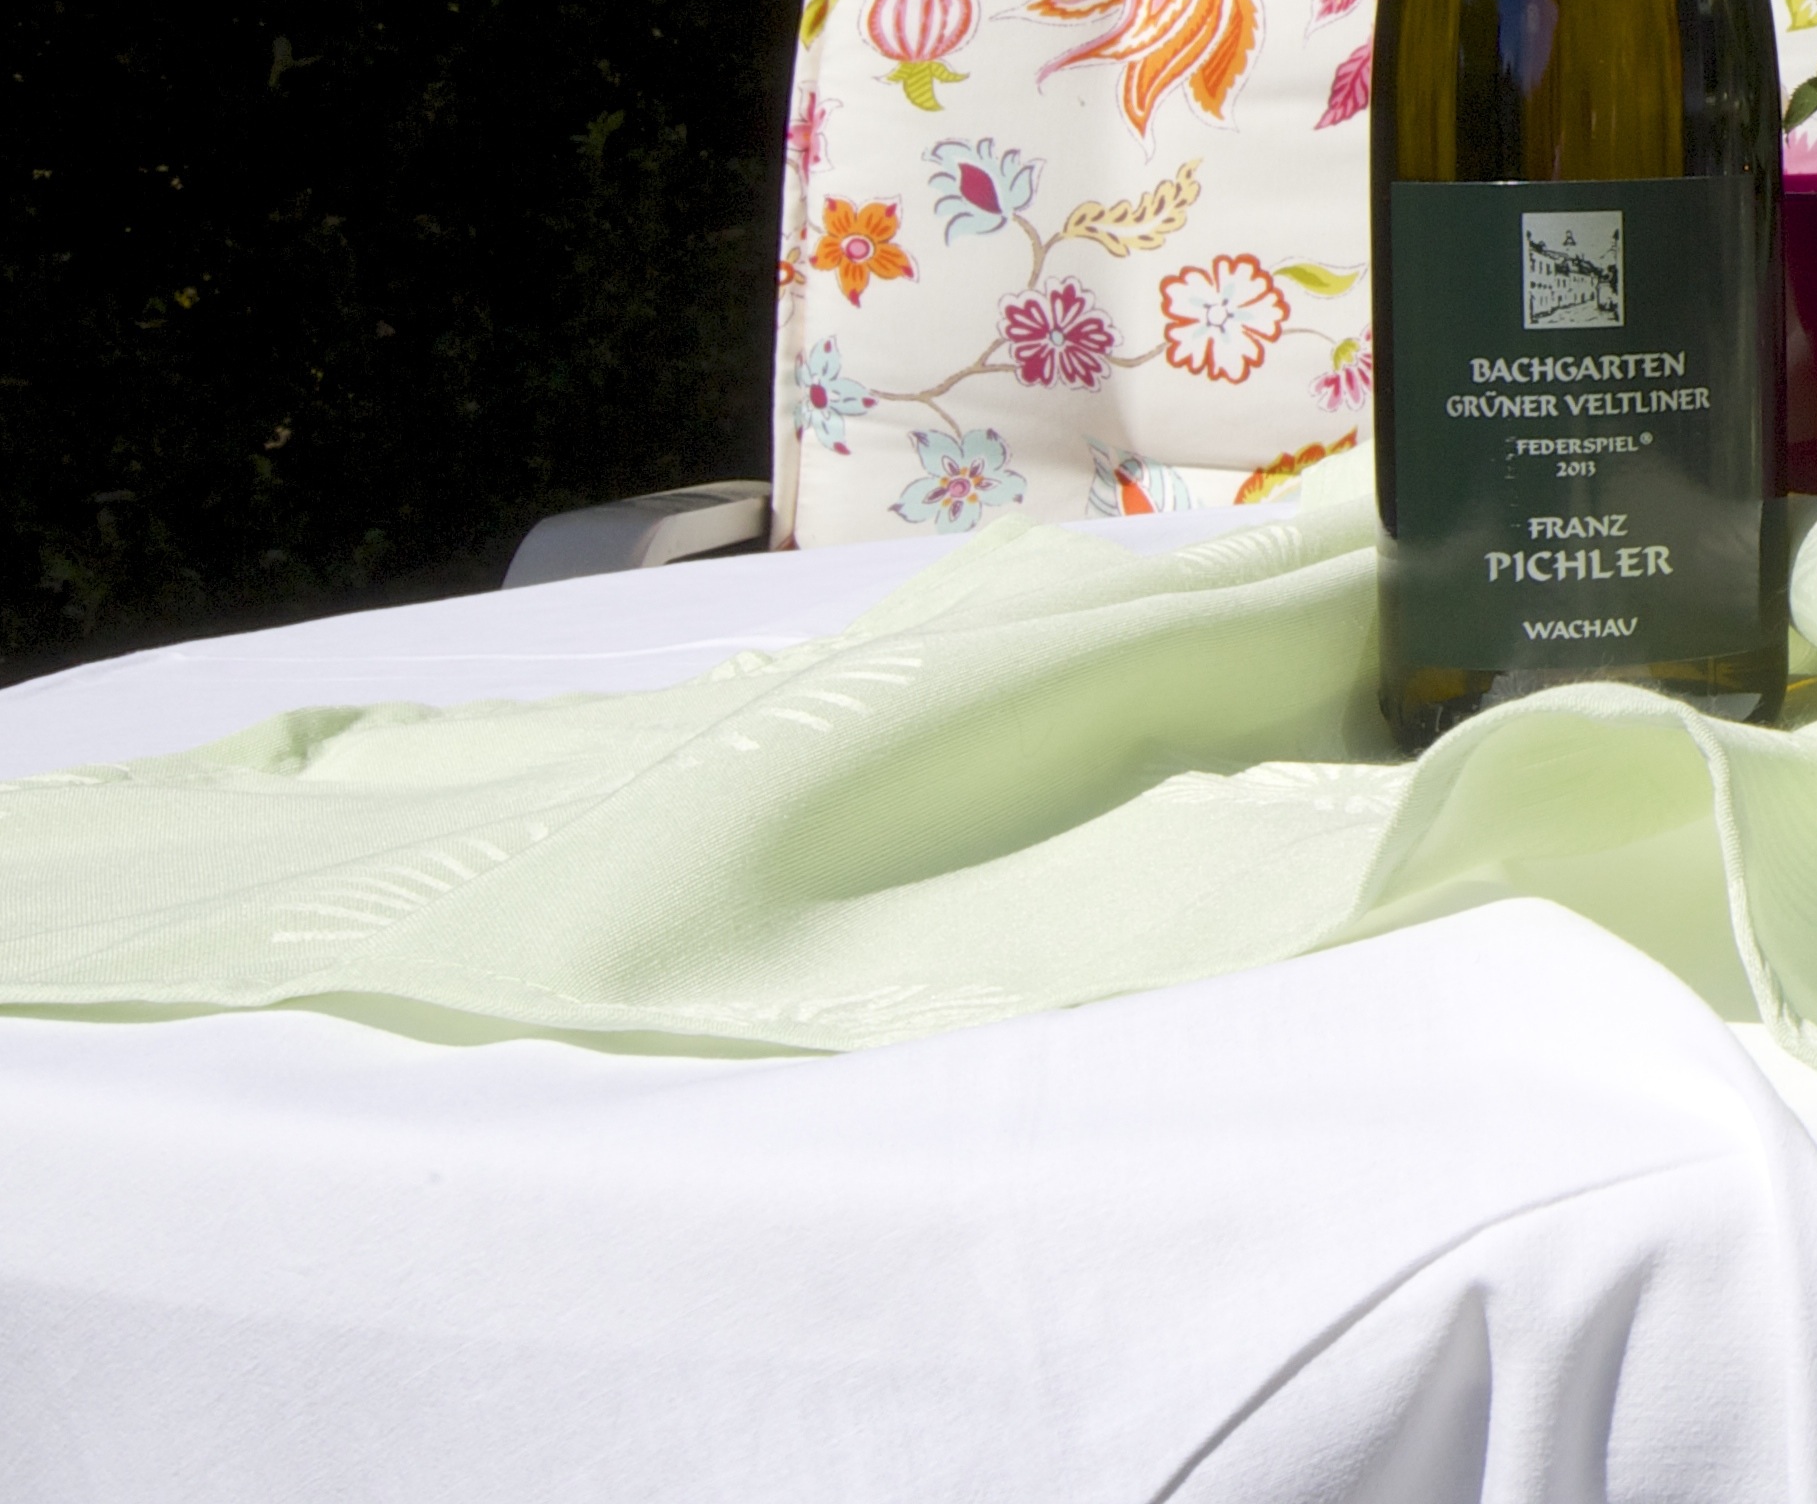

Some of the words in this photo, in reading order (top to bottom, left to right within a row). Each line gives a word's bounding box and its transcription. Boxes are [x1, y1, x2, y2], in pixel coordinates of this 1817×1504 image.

[1470, 351, 1686, 383] BACHGARTEN
[1446, 390, 1559, 418] GRÜNER
[1564, 387, 1710, 415] VELTLINER
[1556, 461, 1596, 477] 2013
[1527, 514, 1629, 539] FRANZ
[1484, 545, 1673, 583] PICHLER
[1522, 617, 1638, 640] WACHAU
